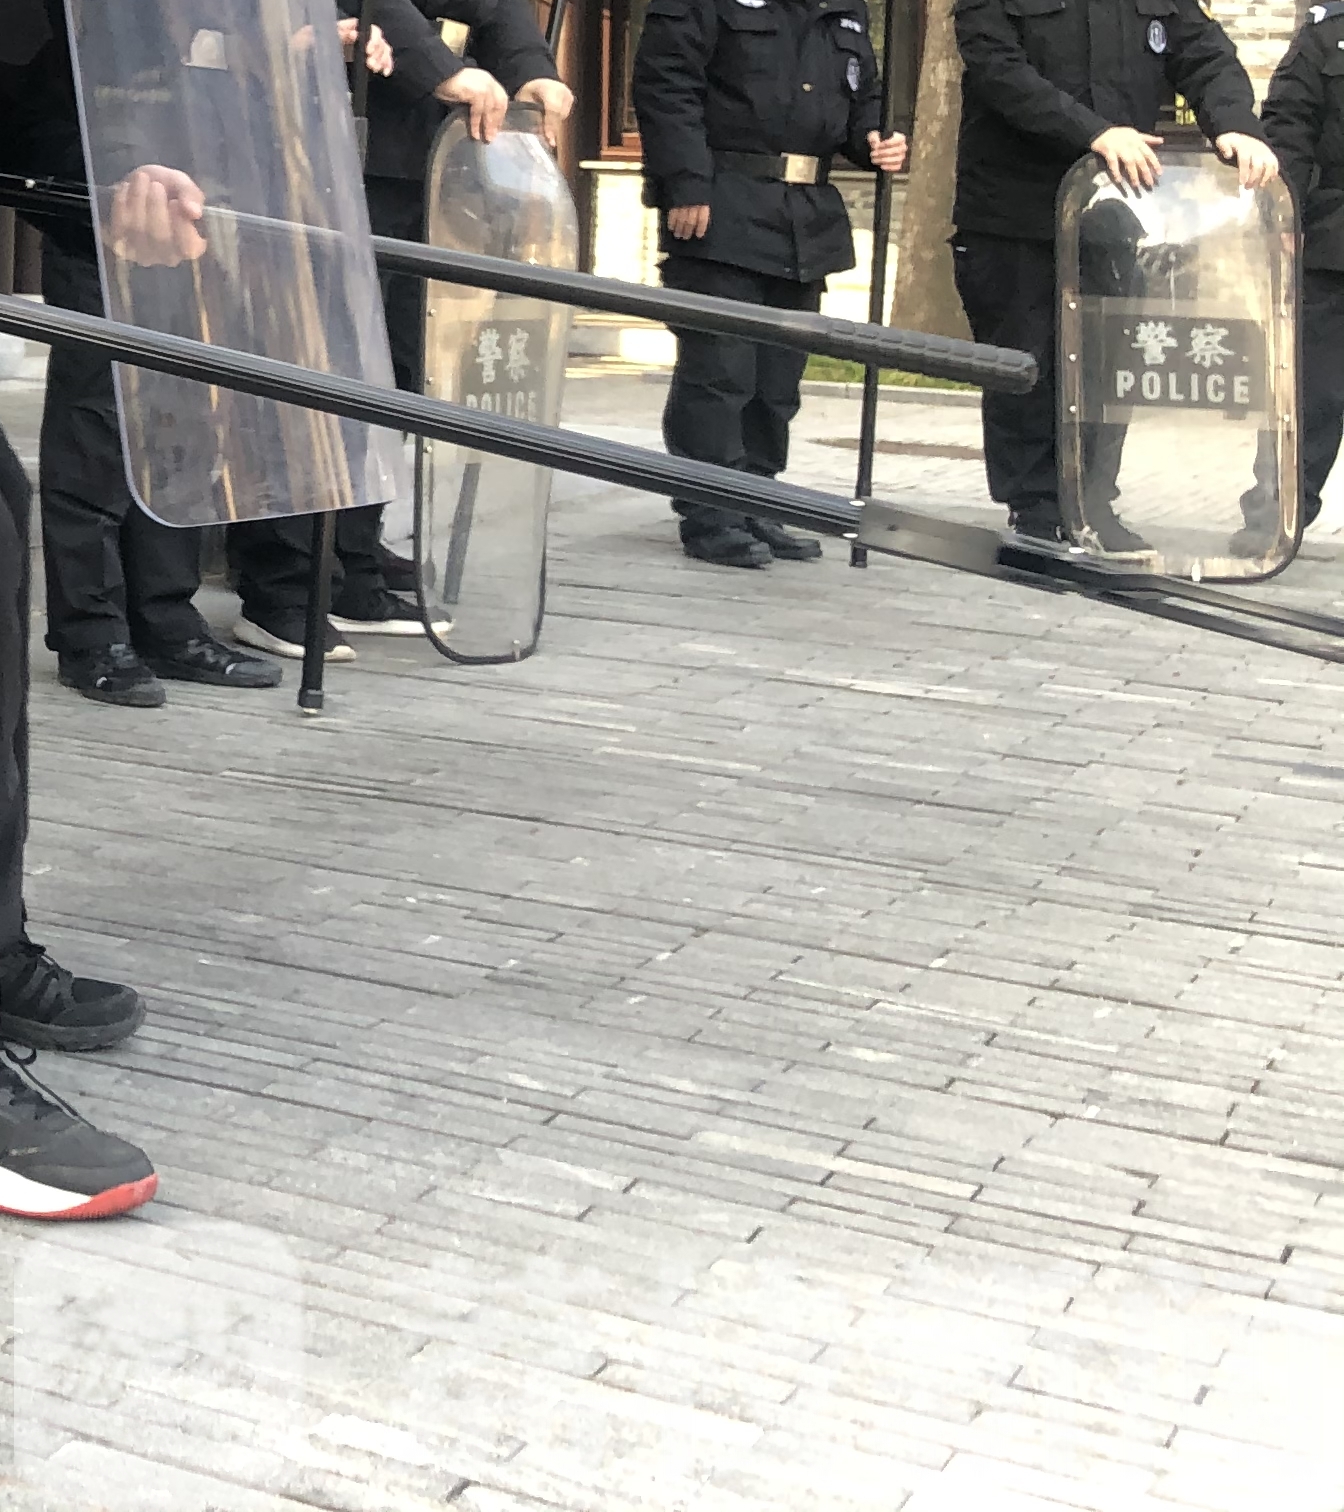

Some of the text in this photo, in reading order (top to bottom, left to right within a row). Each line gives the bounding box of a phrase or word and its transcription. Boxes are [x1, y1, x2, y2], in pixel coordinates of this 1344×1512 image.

[475, 327, 530, 384] 警察
[1131, 320, 1235, 369] 警察
[1116, 369, 1250, 404] POLICE
